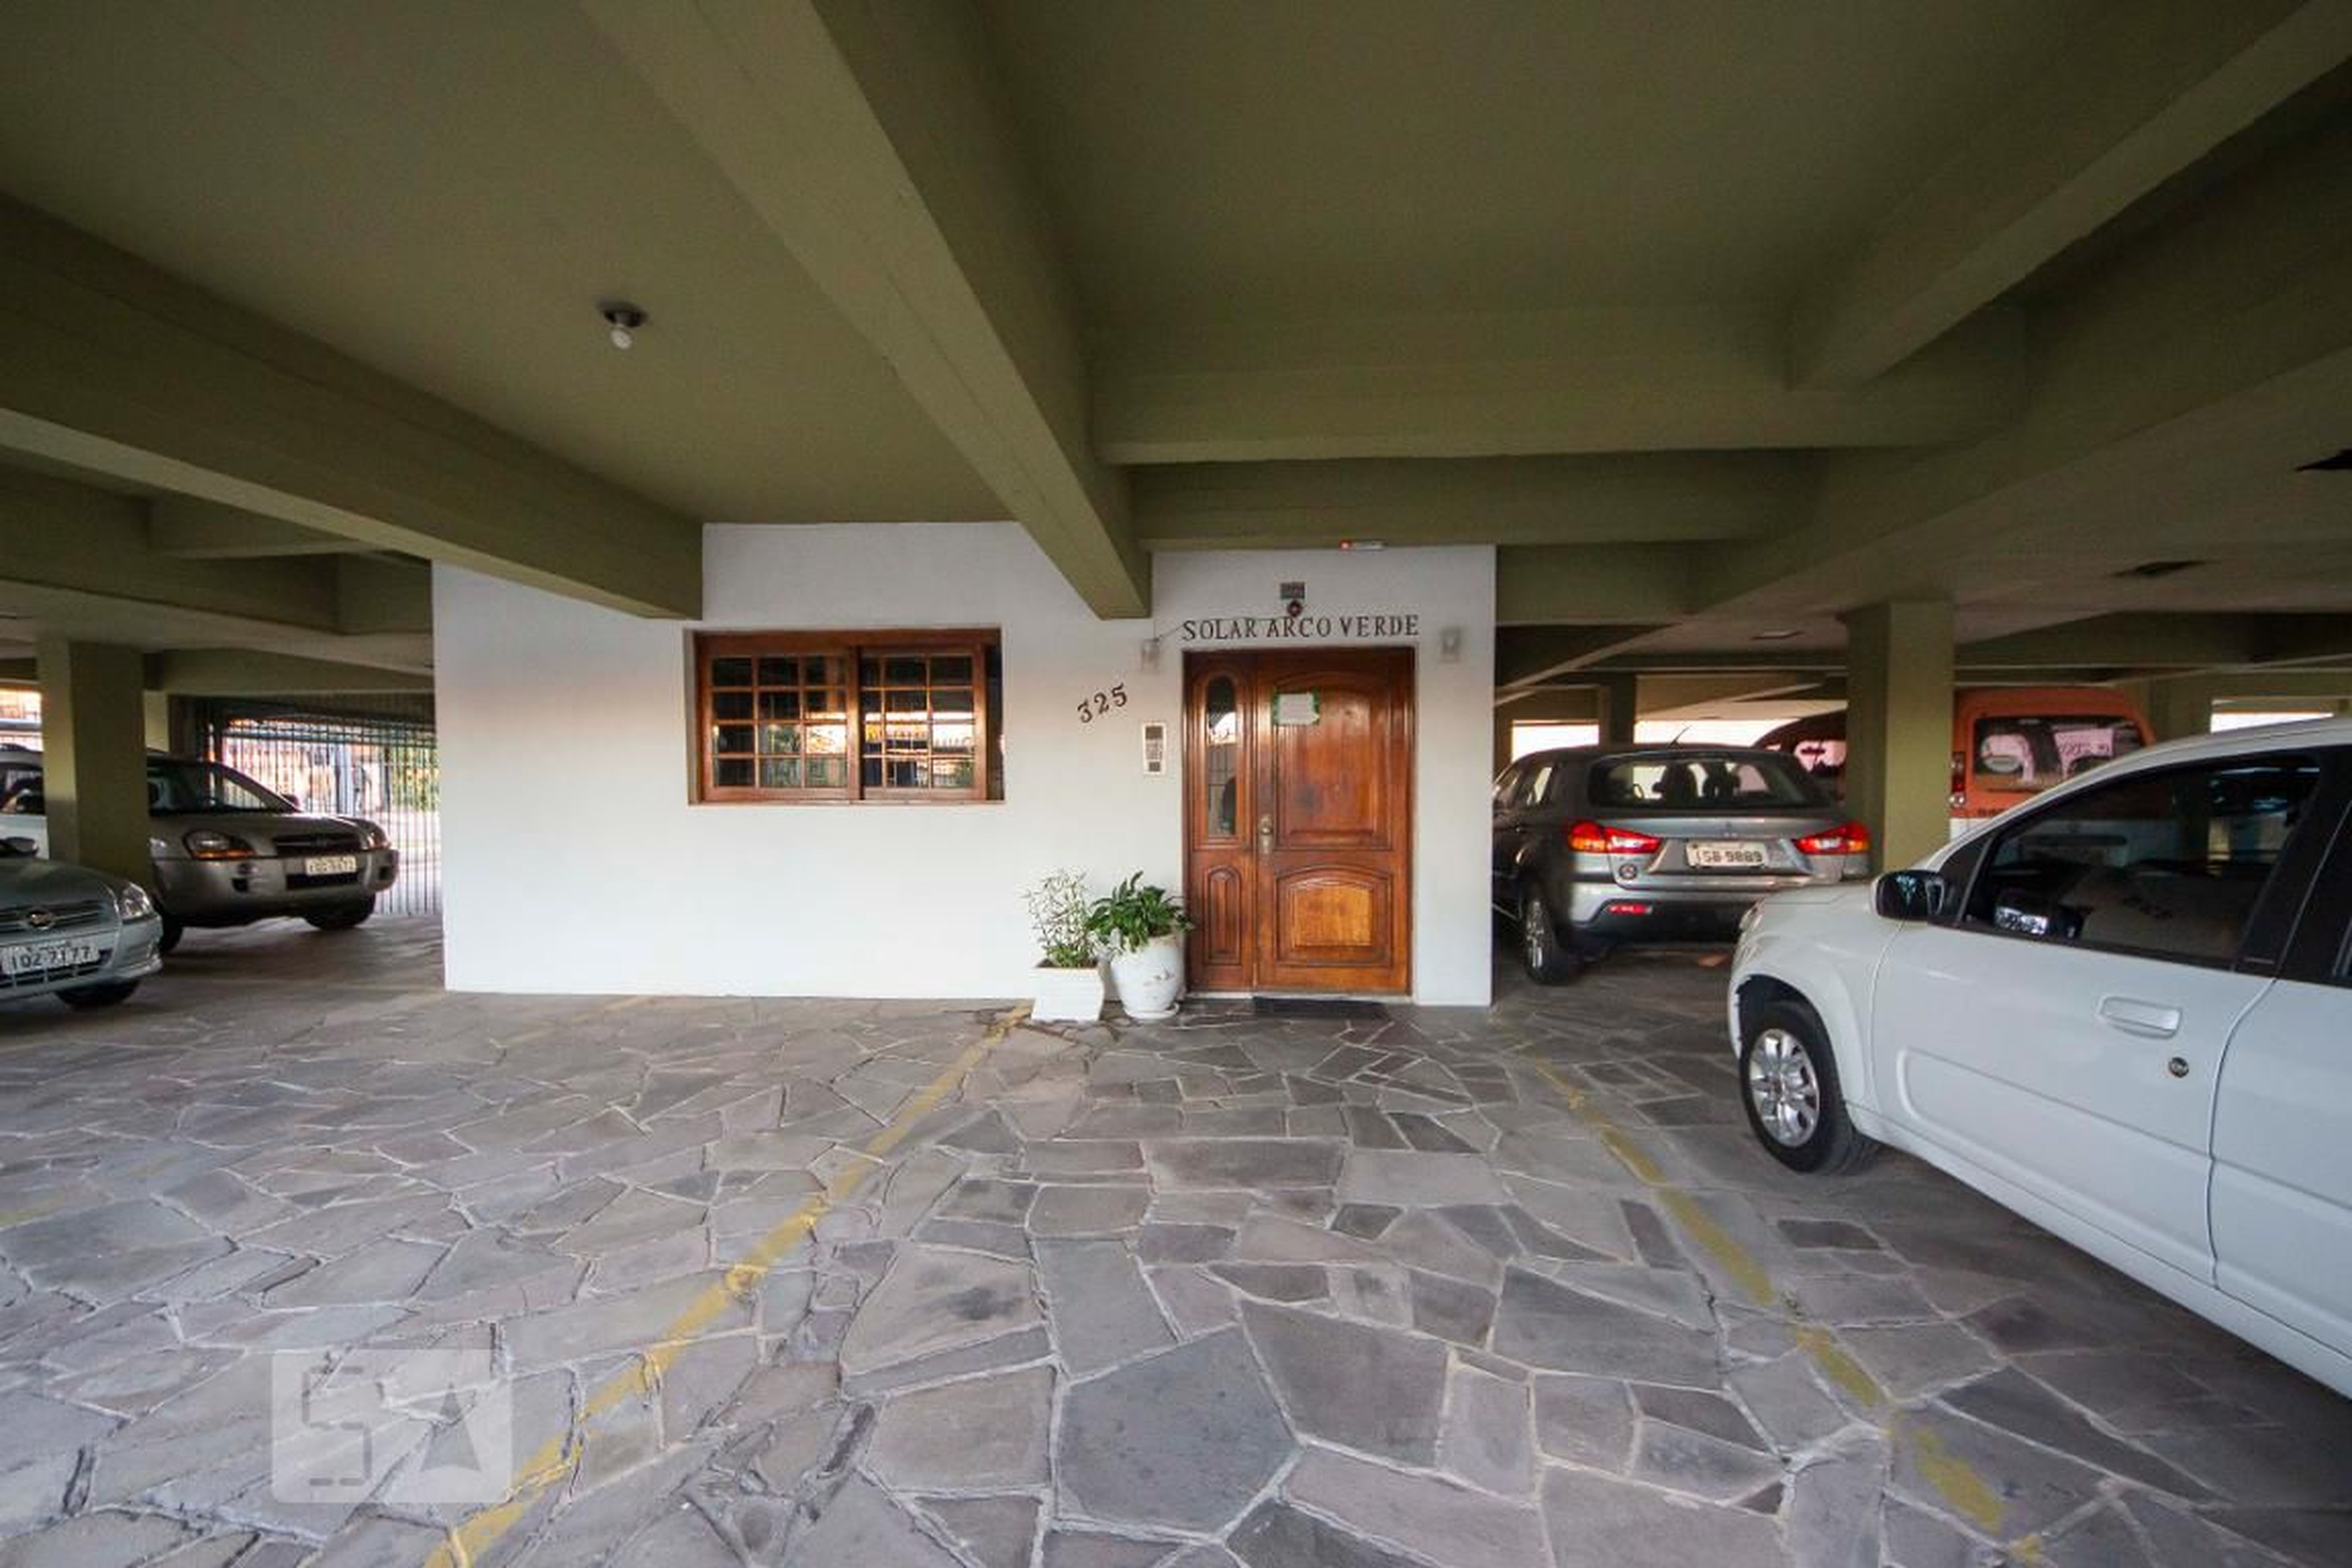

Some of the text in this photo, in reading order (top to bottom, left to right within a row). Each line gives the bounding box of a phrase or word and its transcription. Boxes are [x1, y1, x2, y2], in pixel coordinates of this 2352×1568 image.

[1182, 614, 1419, 641] SOLAR ARCO VERDE
[1077, 682, 1128, 723] 325
